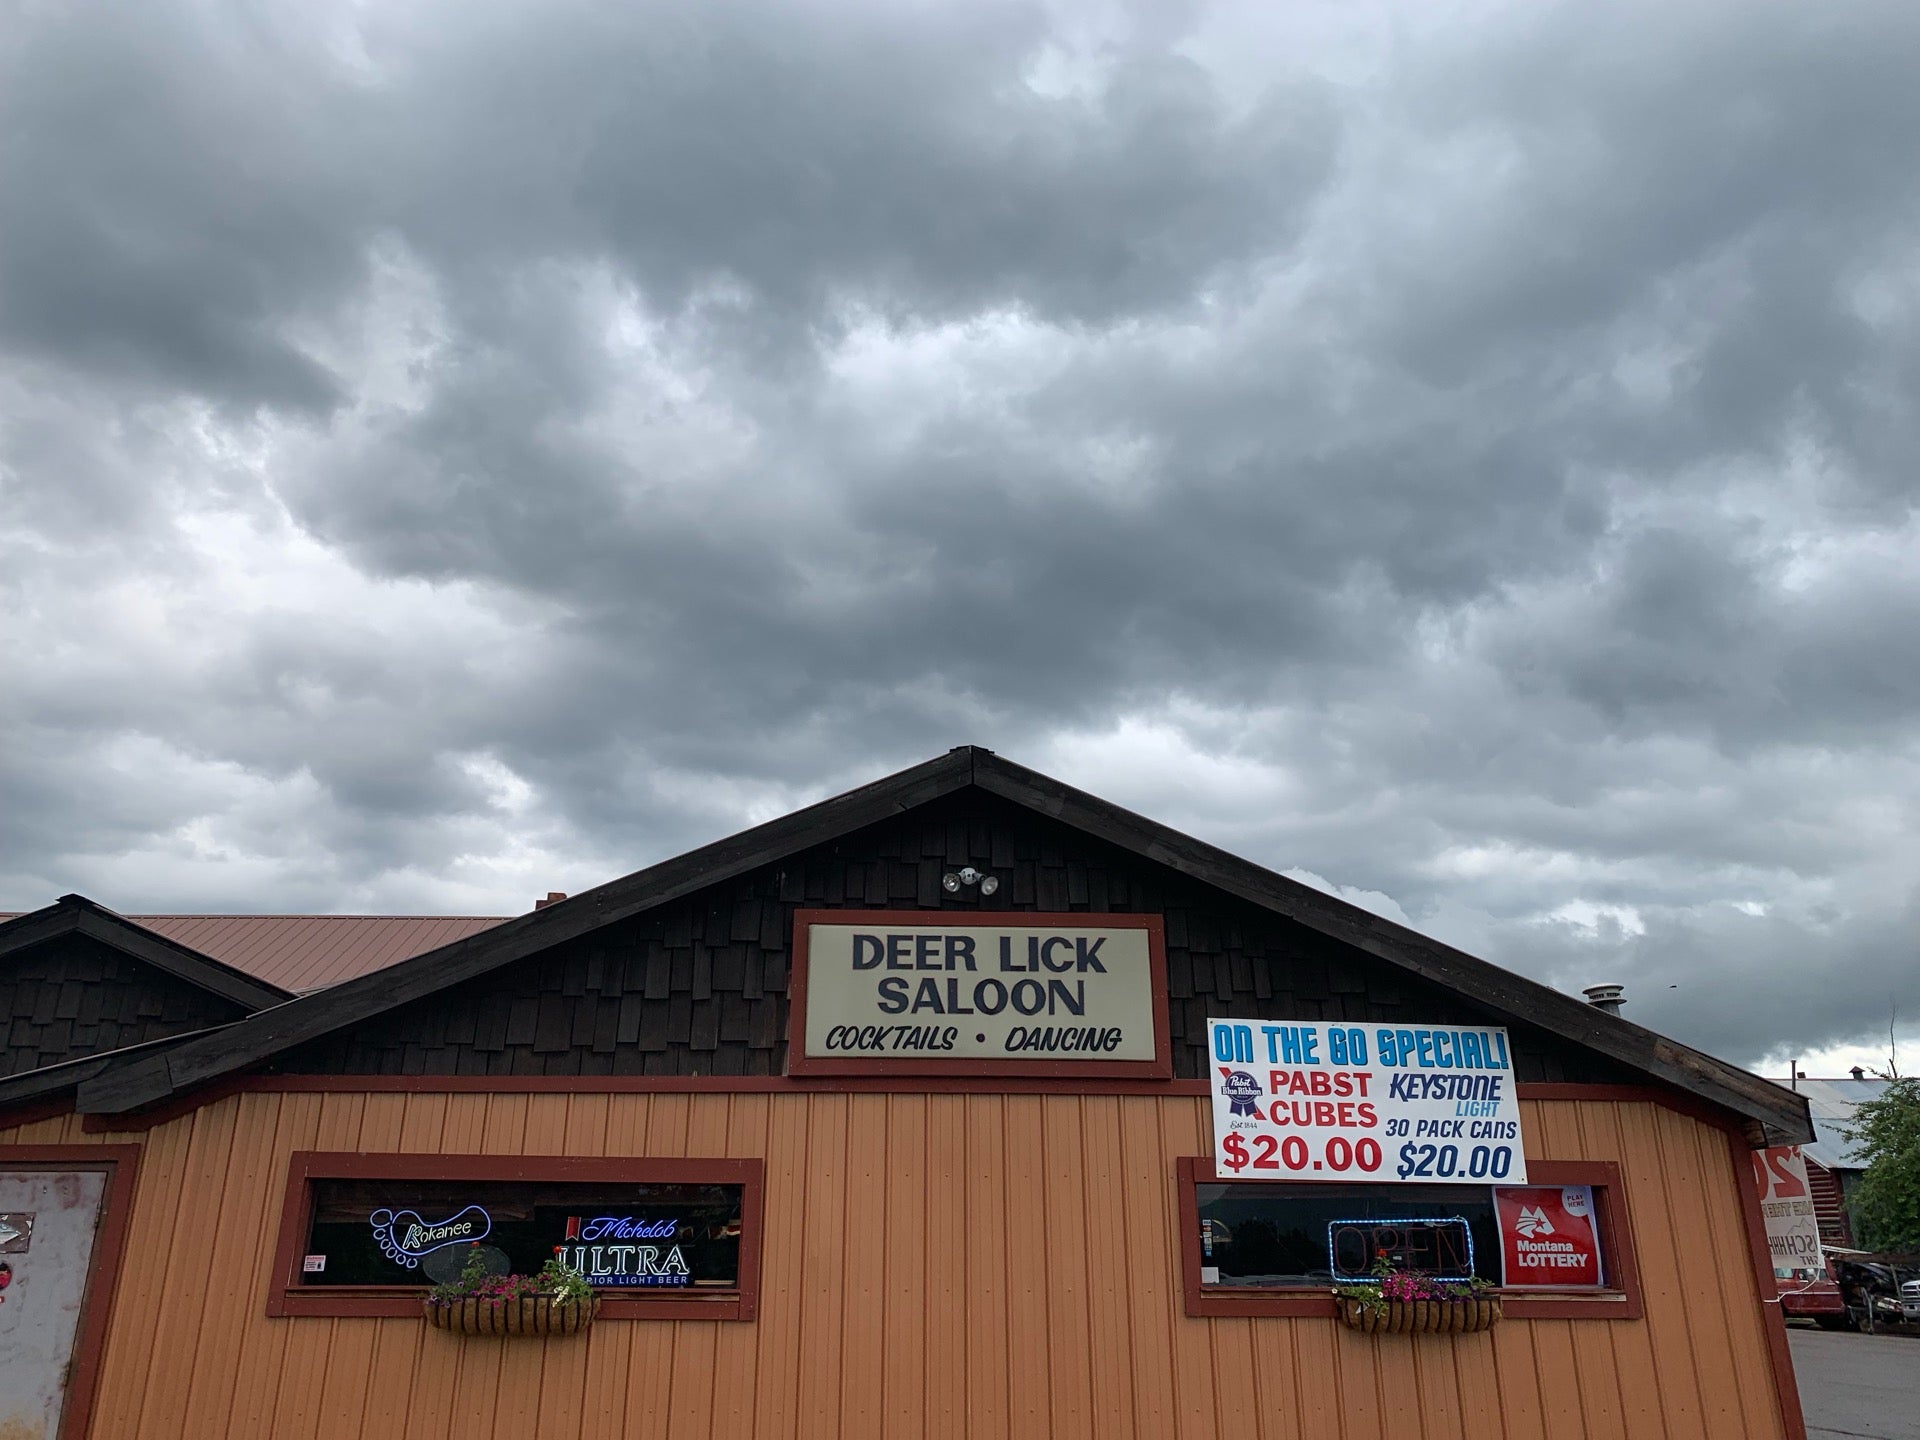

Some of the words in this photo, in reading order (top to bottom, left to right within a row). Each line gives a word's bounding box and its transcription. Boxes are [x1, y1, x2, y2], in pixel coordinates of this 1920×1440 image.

[852, 934, 977, 972] DEER
[999, 936, 1108, 974] LICK
[877, 977, 1086, 1017] SALOON
[826, 1025, 958, 1051] COCKTAILS
[1005, 1027, 1122, 1052] DANCING
[1213, 1024, 1254, 1063] ON
[1261, 1025, 1320, 1065] THE
[1327, 1027, 1369, 1066] GO
[1377, 1029, 1510, 1070] SPECIAL!
[1222, 1086, 1238, 1095] Blue
[1238, 1087, 1261, 1096] Ribbon
[1230, 1075, 1251, 1086] Pabst
[1269, 1070, 1373, 1098] PABST
[1389, 1073, 1504, 1102] KEYSTONE
[1269, 1101, 1378, 1128] CUBES
[1455, 1101, 1500, 1118] LIGHT
[1385, 1119, 1410, 1137] 30
[1416, 1120, 1463, 1138] PACK
[1470, 1121, 1517, 1139] CANS
[1222, 1131, 1382, 1173] $20.00
[1396, 1141, 1512, 1180] $20.00
[1566, 1194, 1583, 1202] PLAY
[402, 1222, 472, 1250] Kokanee
[582, 1216, 678, 1241] Michelob
[1334, 1225, 1469, 1276] OPEN
[1516, 1240, 1574, 1252] Montana
[559, 1244, 690, 1276] ULTRA
[1518, 1253, 1588, 1268] LOTTERY
[619, 1276, 652, 1284] LIGHT
[658, 1276, 688, 1284] BEER
